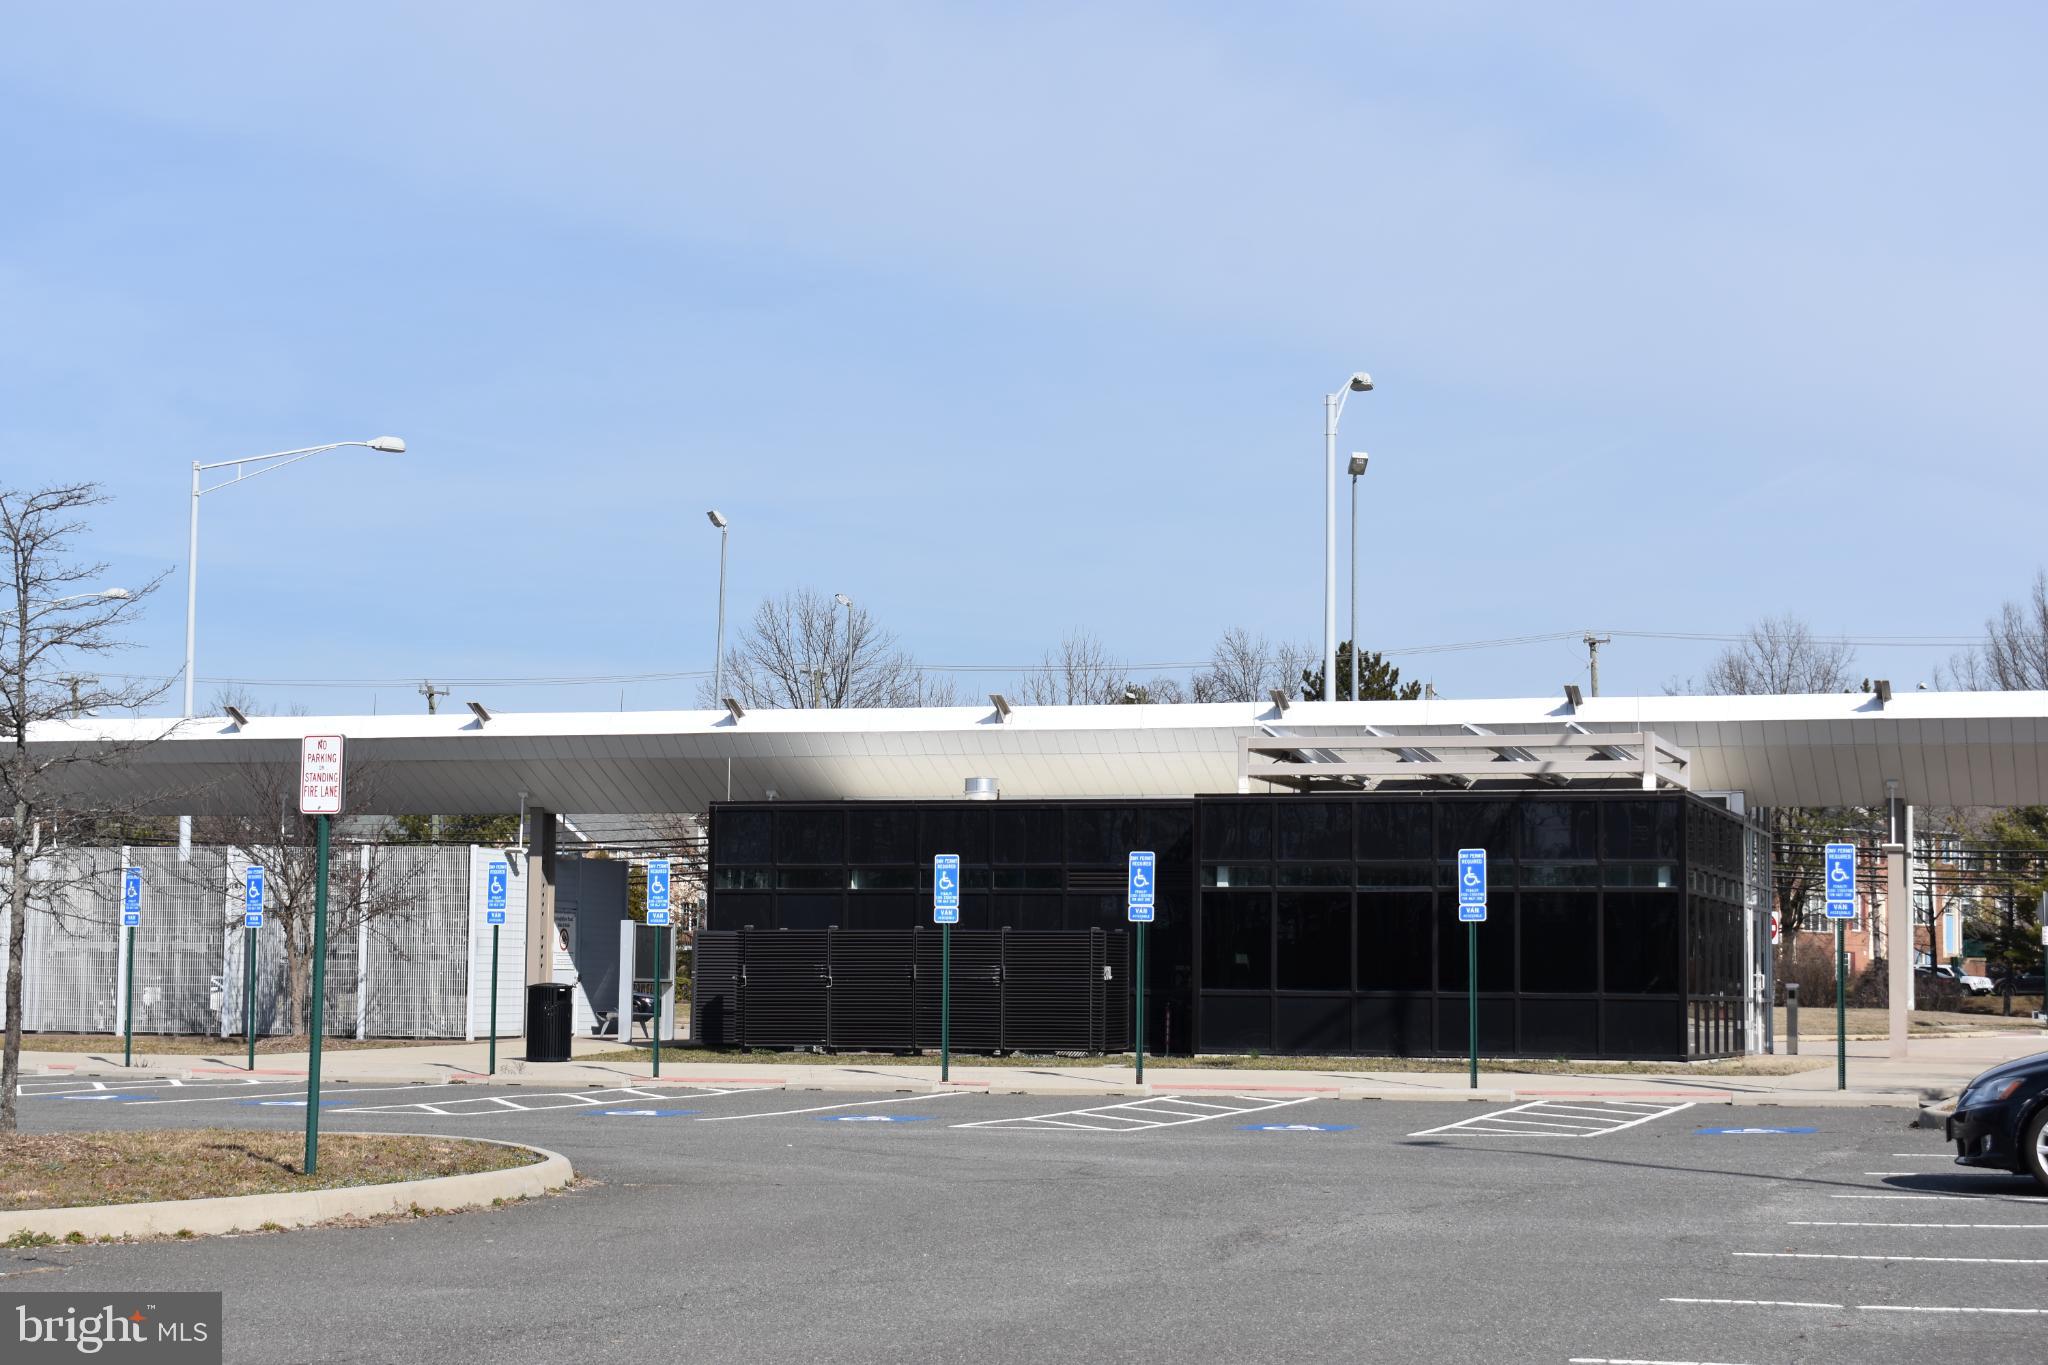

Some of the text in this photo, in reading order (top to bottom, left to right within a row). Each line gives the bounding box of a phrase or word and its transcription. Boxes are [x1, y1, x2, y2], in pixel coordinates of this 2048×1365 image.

[318, 740, 327, 750] NO
[308, 753, 336, 763] PARKING
[304, 772, 338, 782] STANDING
[304, 786, 338, 798] FIRE LANE
